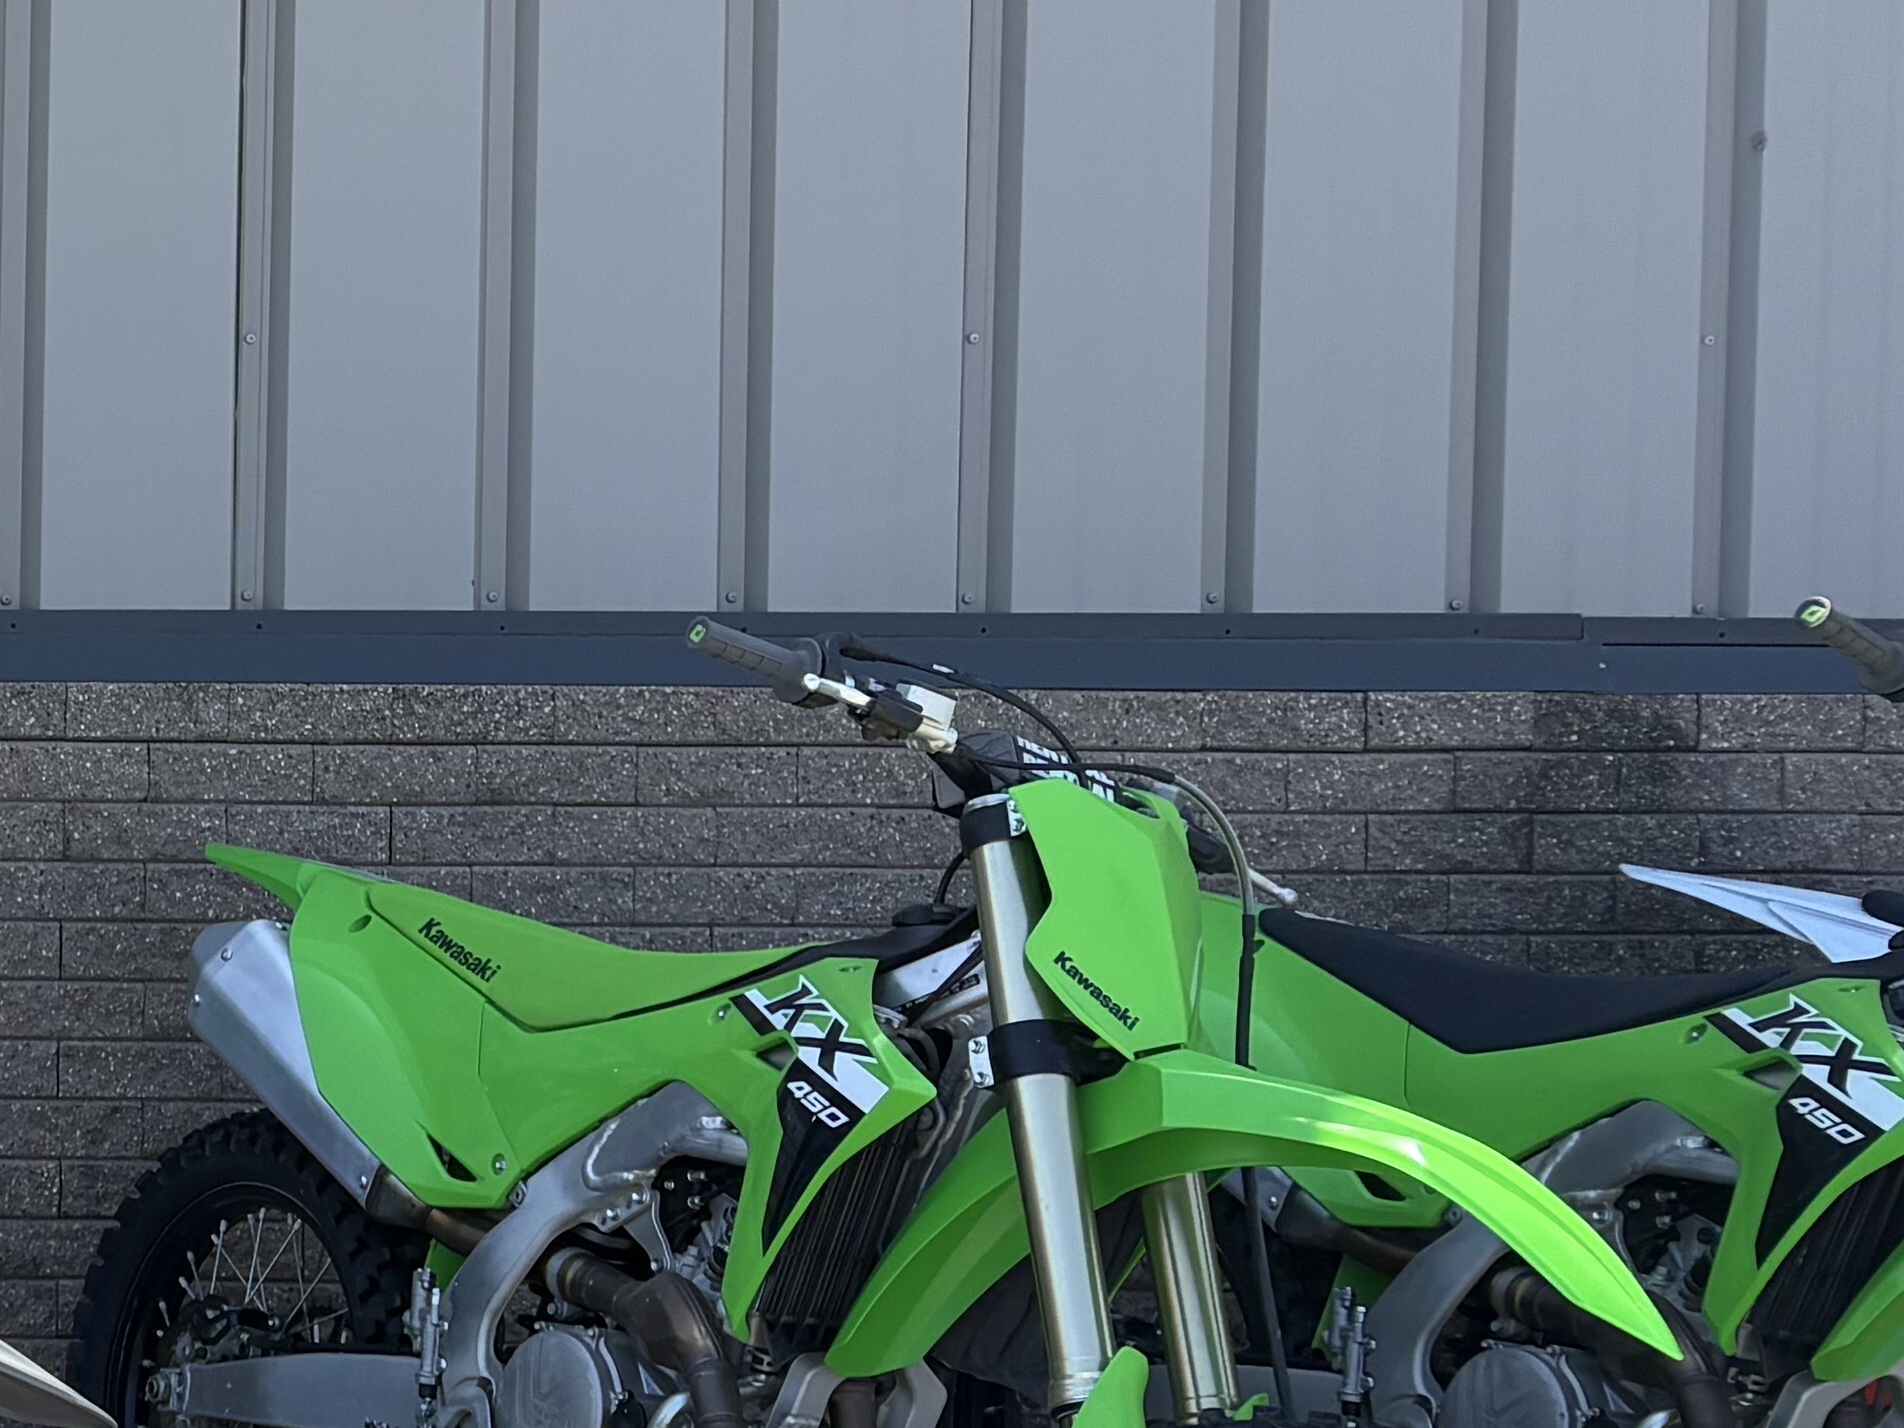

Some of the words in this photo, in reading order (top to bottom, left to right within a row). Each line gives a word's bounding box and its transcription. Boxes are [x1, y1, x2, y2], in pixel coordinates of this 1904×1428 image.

[417, 917, 504, 985] Kawasaki
[763, 974, 879, 1082] KX
[1052, 949, 1140, 1033] Kawasaki
[1748, 993, 1902, 1101] KX
[786, 1080, 850, 1128] 450
[1788, 1096, 1866, 1145] 450
